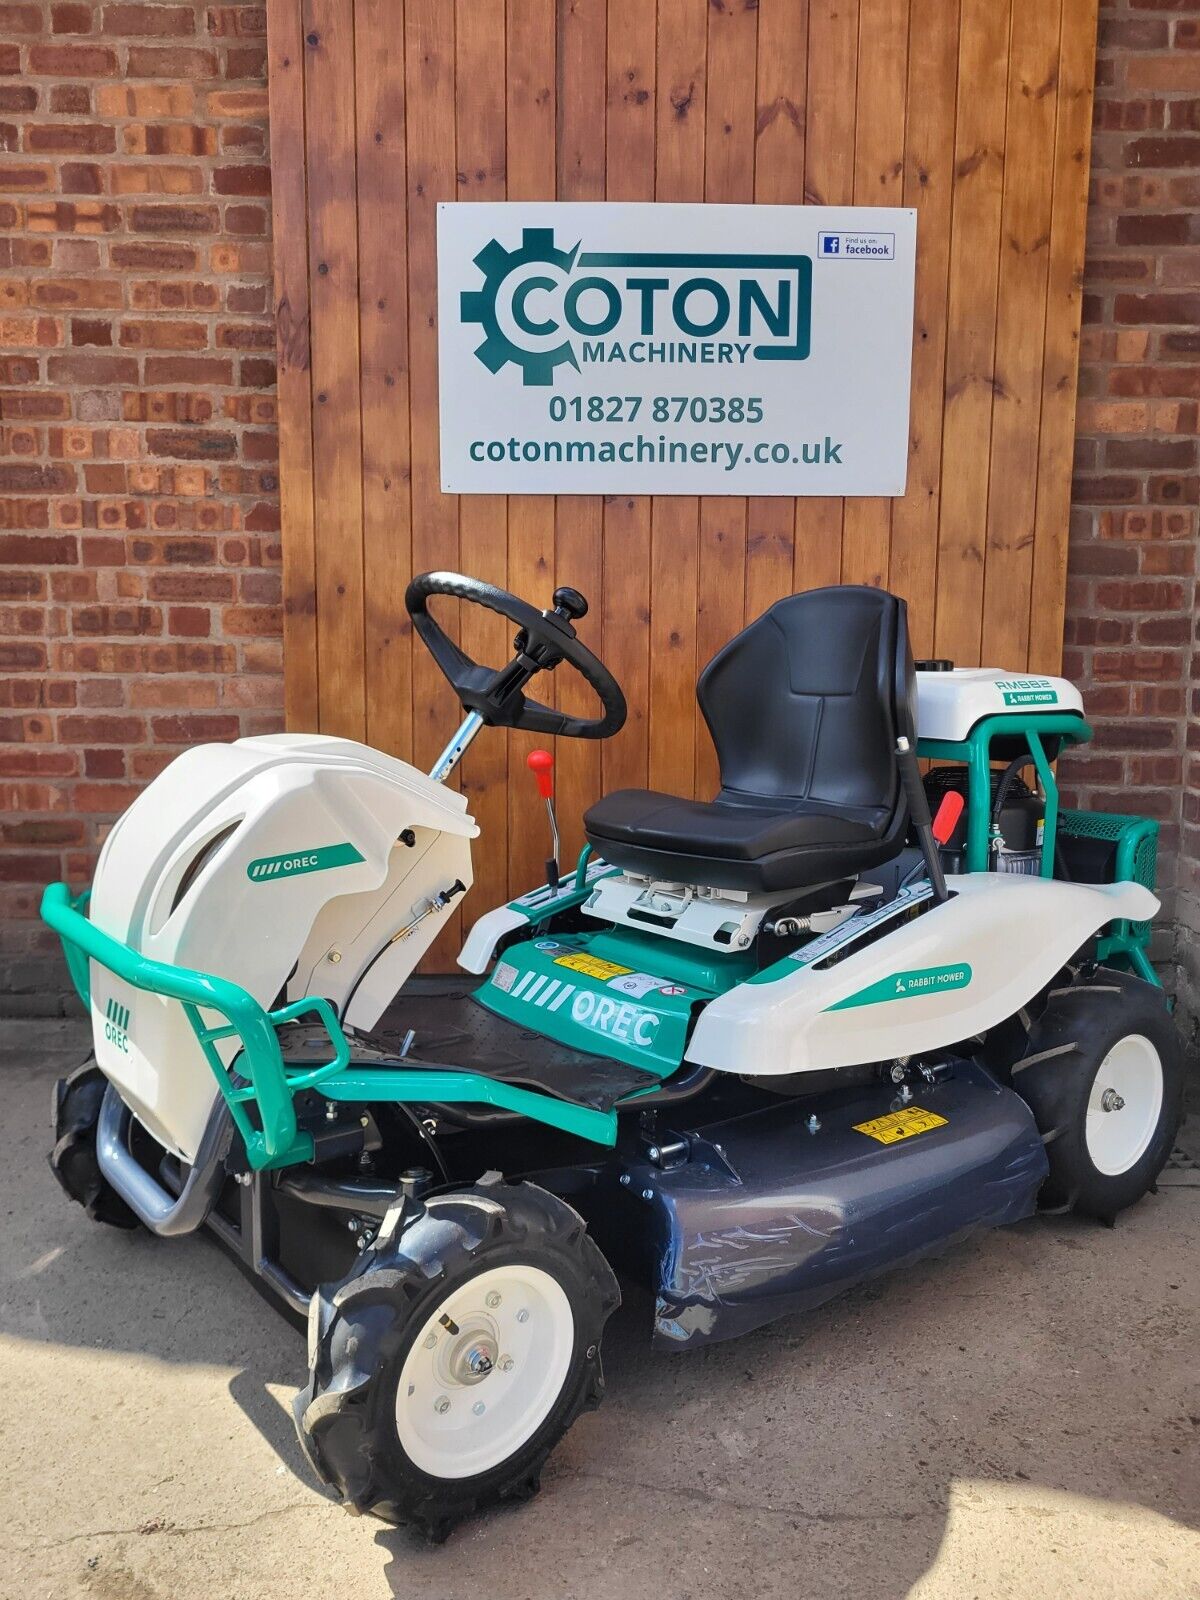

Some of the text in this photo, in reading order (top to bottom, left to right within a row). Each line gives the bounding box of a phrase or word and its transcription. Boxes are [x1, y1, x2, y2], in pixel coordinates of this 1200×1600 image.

[846, 245, 889, 254] facebook
[510, 276, 792, 338] COTON
[581, 341, 752, 364] MACHINERY
[548, 395, 764, 424] 01827 870385
[469, 434, 844, 471] cotonmachinery.co.uk
[283, 855, 319, 871] OREC
[908, 971, 965, 989] RABBIT MOWER
[571, 990, 660, 1046] OREC
[105, 1022, 128, 1053] OREC
